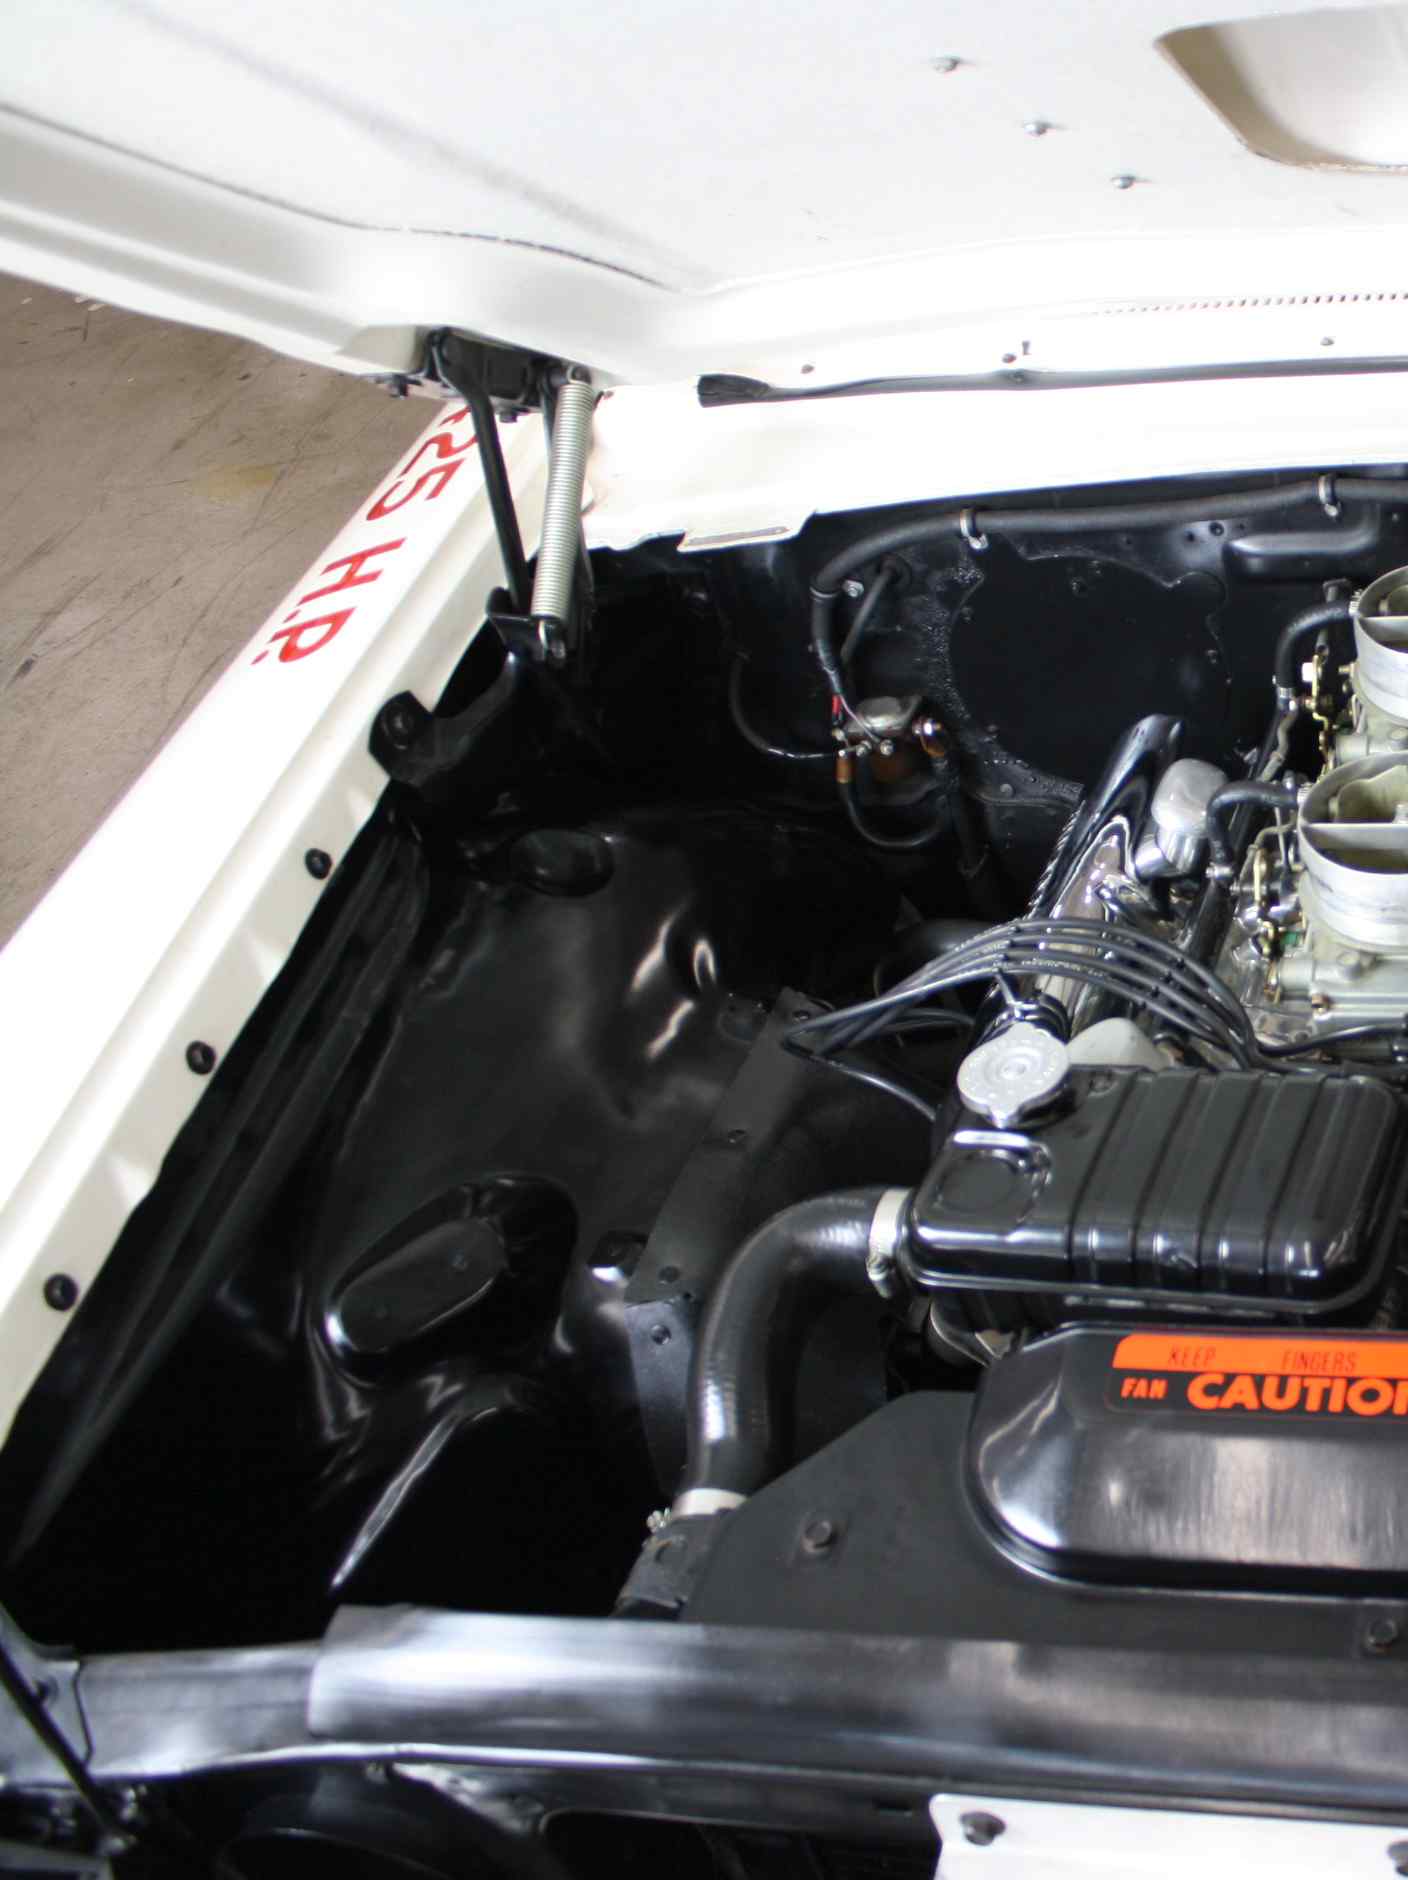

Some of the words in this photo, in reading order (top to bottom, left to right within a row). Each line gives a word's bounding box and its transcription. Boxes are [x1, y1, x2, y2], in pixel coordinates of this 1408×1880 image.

[1167, 1345, 1216, 1368] KEEP
[1281, 1349, 1358, 1374] FINGERS
[1120, 1377, 1167, 1400] FAN
